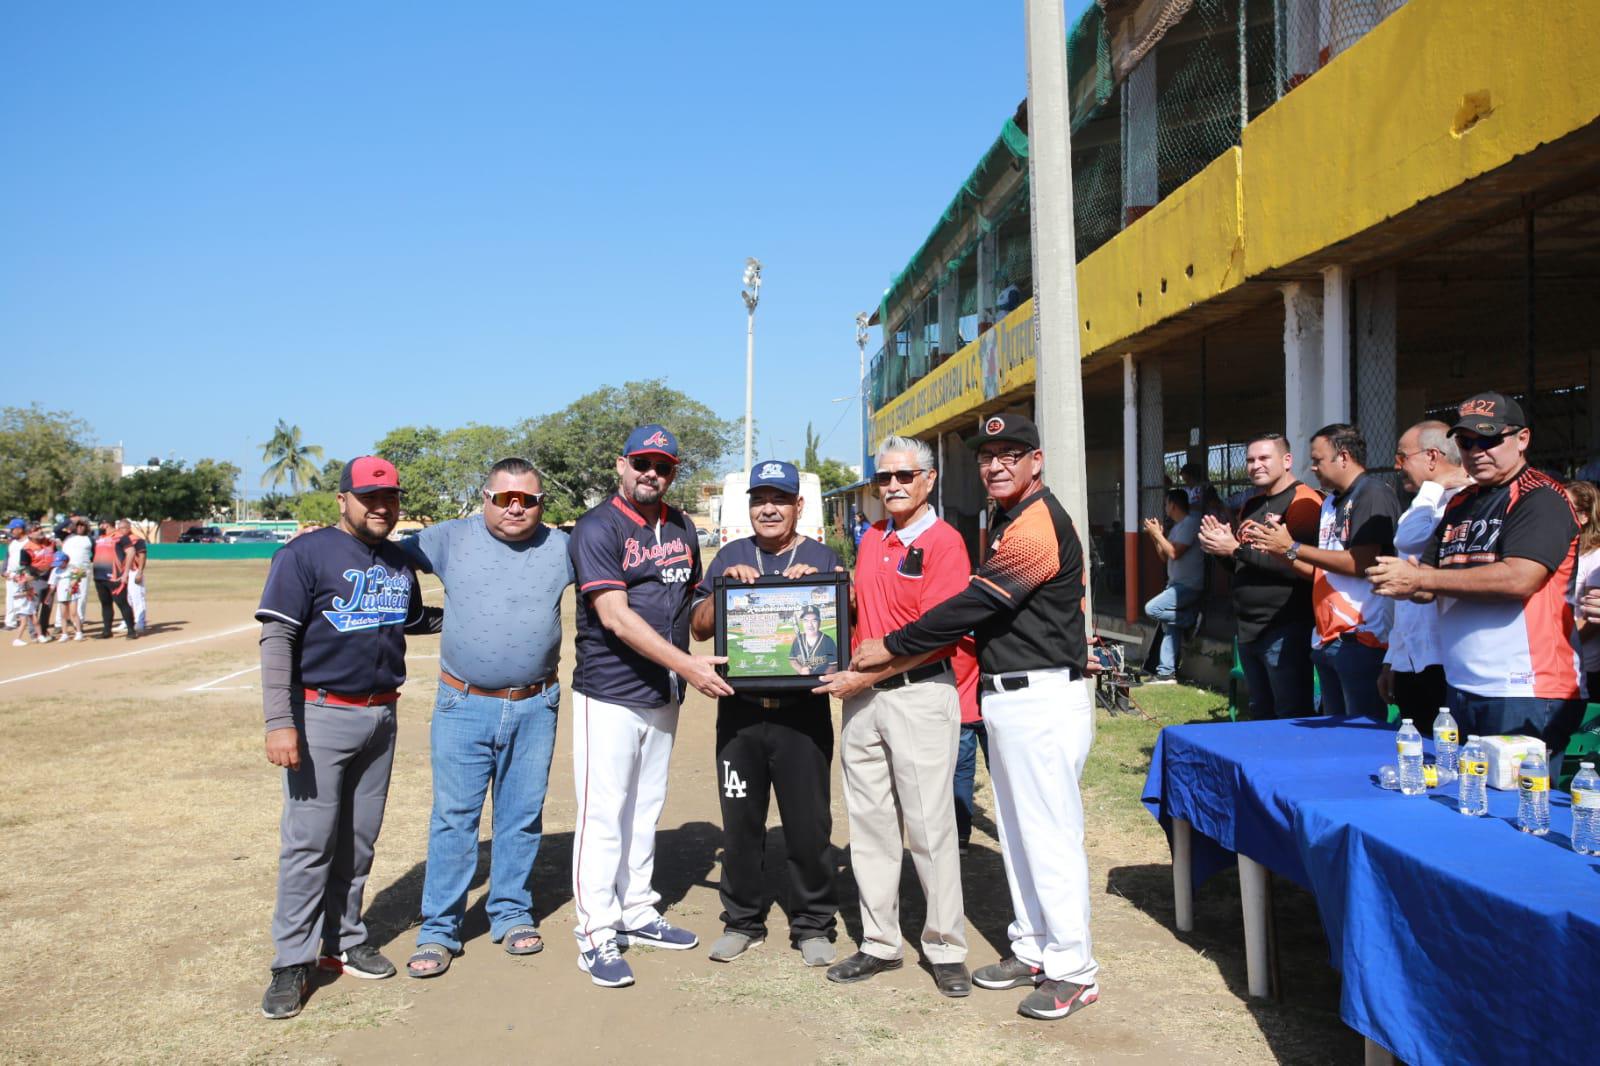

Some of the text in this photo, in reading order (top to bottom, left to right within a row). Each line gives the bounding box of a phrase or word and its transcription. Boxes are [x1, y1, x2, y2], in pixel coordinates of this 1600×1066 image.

[1476, 399, 1496, 413] 27
[1466, 518, 1503, 552] 27
[622, 537, 684, 571] Braves
[723, 760, 747, 798] LA
